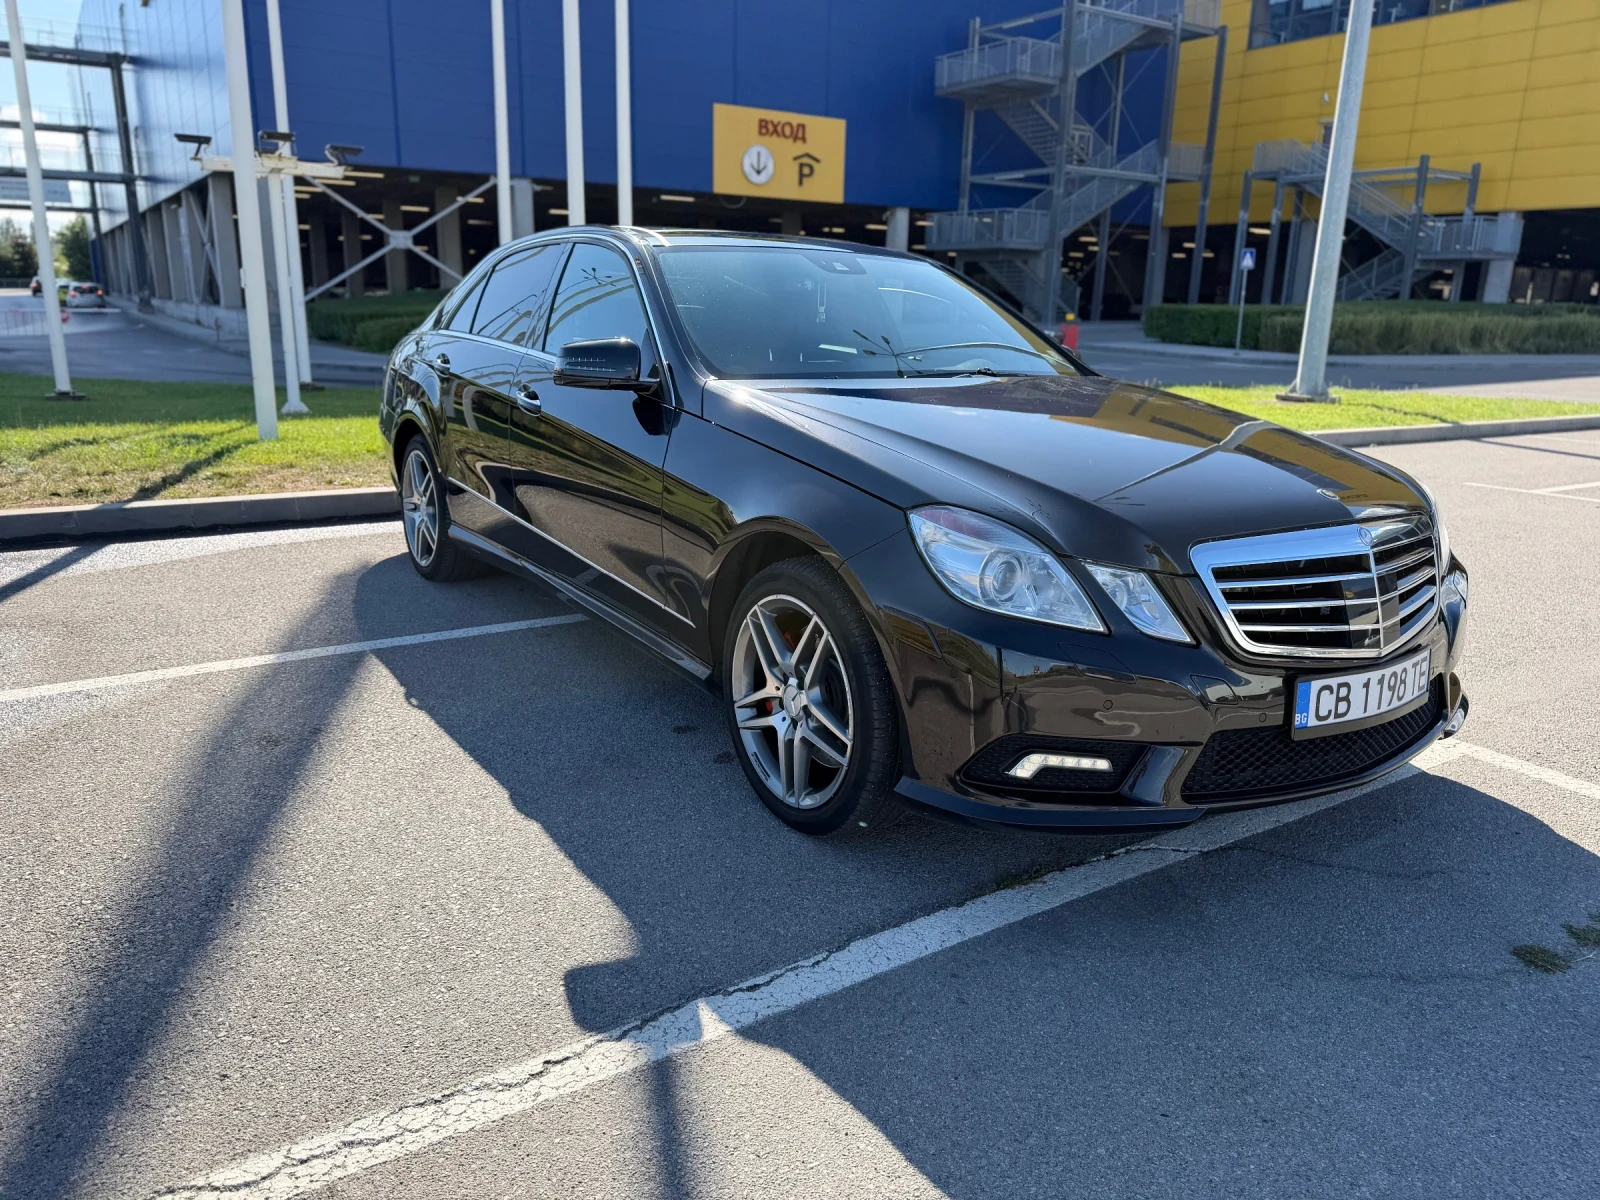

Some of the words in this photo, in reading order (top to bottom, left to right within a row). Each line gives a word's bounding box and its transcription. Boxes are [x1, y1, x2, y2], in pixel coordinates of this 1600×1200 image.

[758, 118, 807, 144] ВХОД
[798, 162, 815, 187] P
[1314, 681, 1352, 722] CB
[1362, 667, 1408, 714] 1198
[1411, 655, 1428, 697] TE
[1295, 712, 1308, 726] BG
